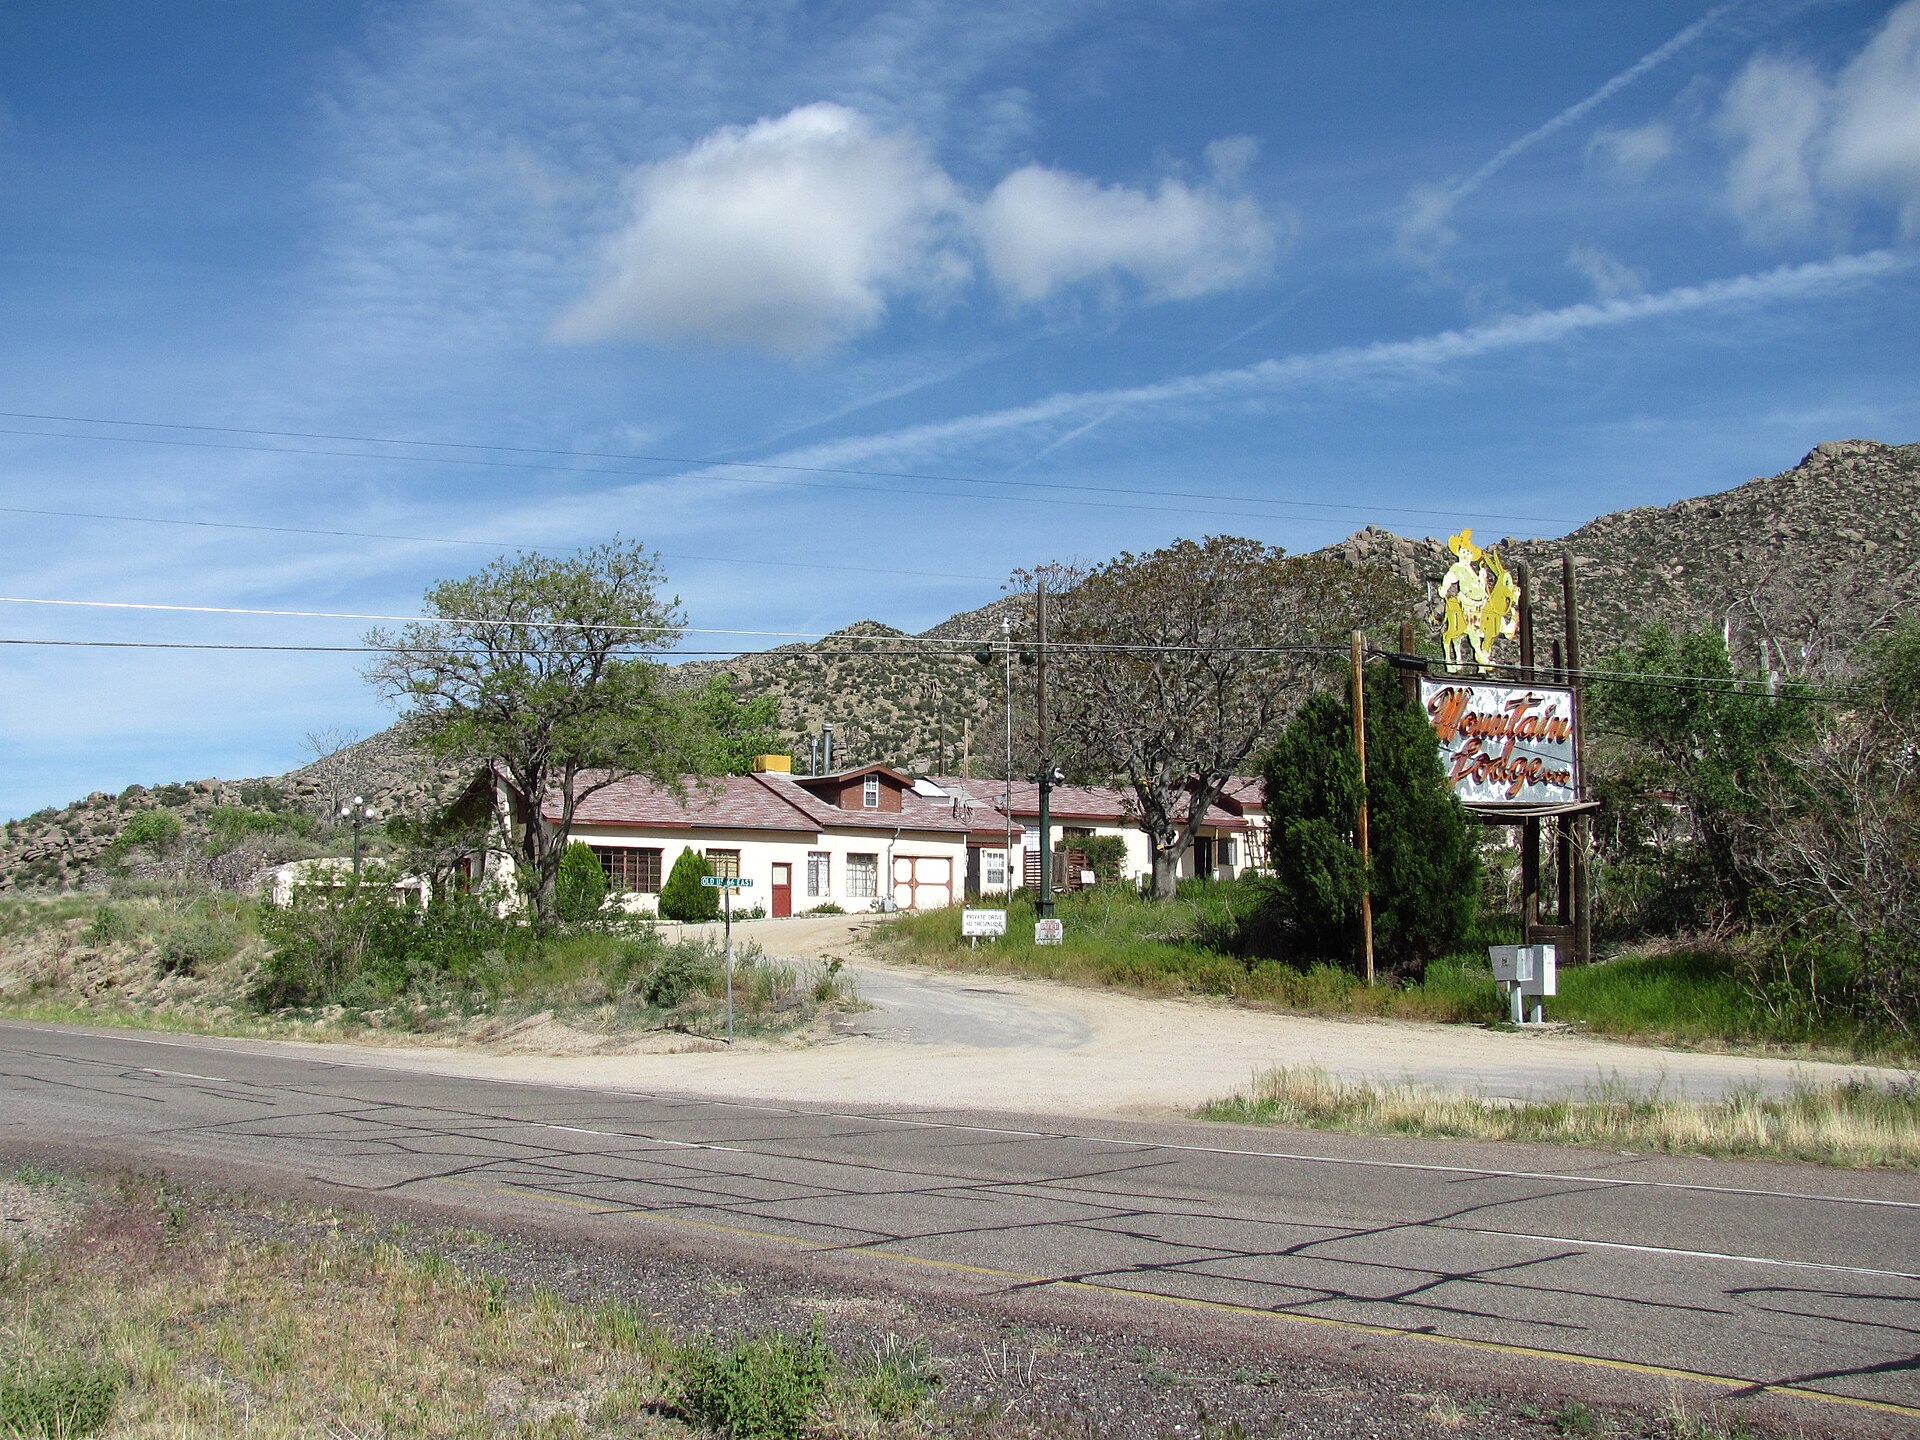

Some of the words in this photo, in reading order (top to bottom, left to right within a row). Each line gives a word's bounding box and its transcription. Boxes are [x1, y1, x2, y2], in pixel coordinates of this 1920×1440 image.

[1449, 737, 1546, 800] Lodge
[702, 877, 715, 885] OLD
[736, 879, 753, 887] EAST
